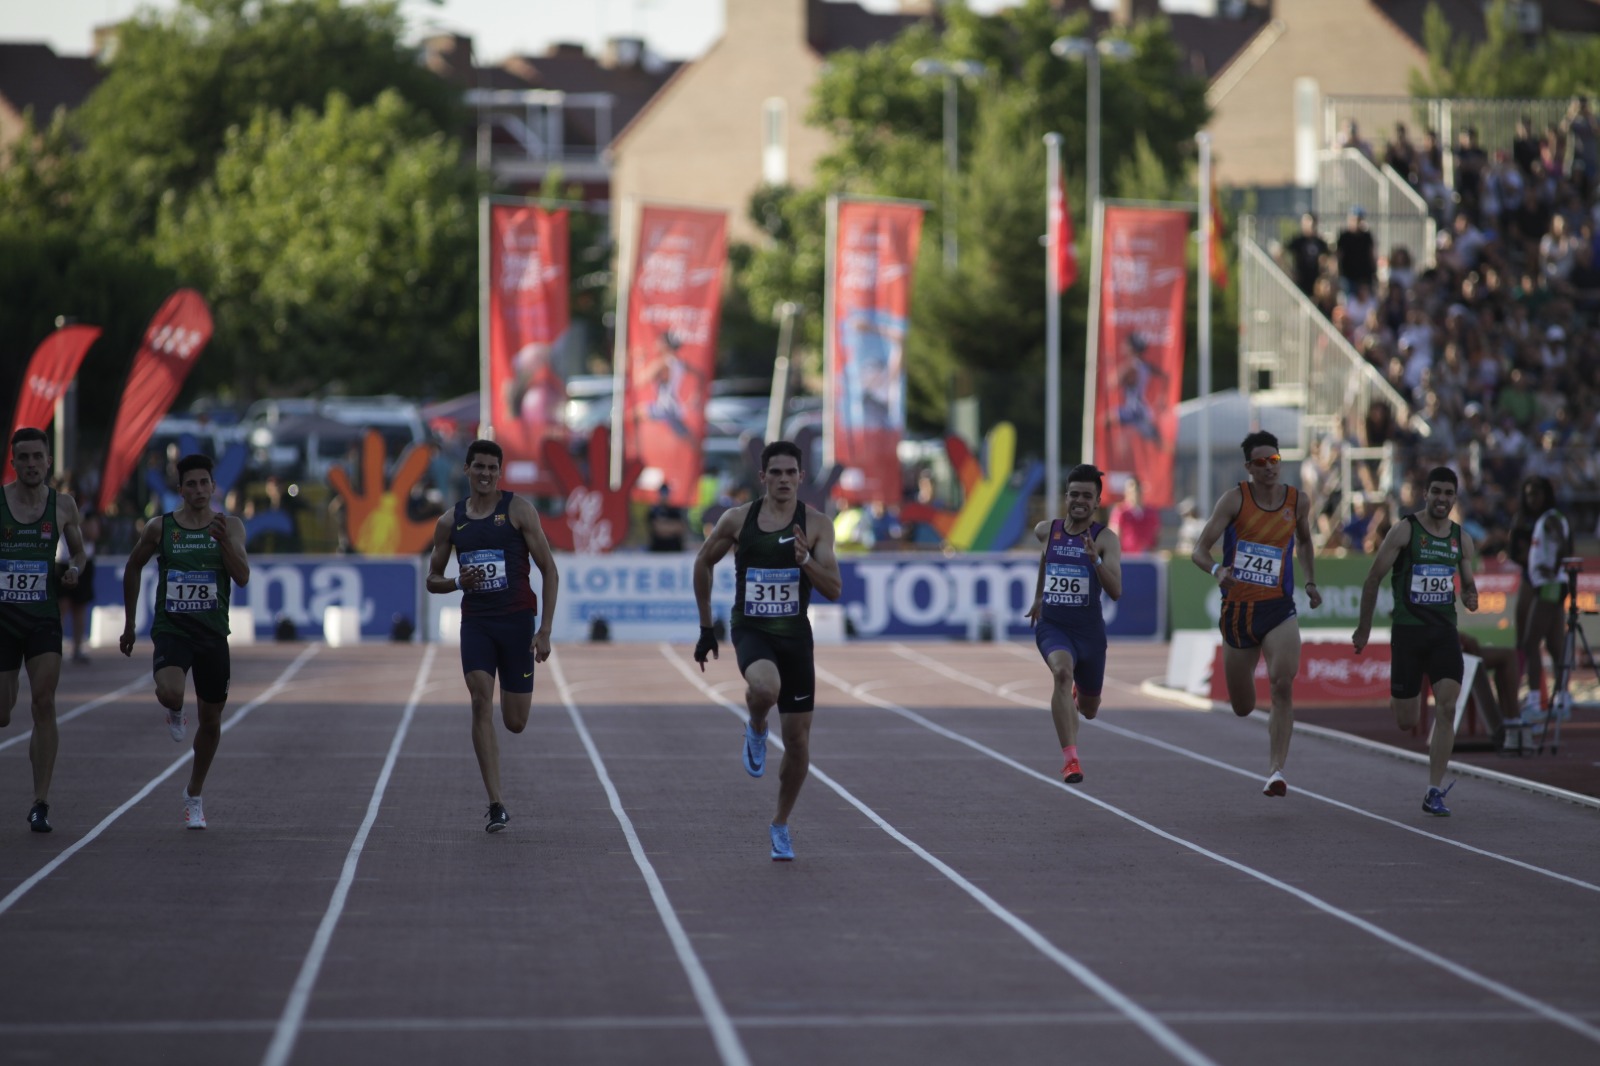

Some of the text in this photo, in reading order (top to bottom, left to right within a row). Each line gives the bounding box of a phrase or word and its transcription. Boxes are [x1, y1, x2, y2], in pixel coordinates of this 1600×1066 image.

[469, 563, 497, 579] 59
[1243, 555, 1273, 573] 744
[7, 574, 39, 590] 187
[566, 561, 735, 594] LOTERÍS
[1049, 577, 1080, 593] 296
[1420, 577, 1448, 592] 190
[176, 584, 209, 599] 178
[754, 584, 790, 601] 315
